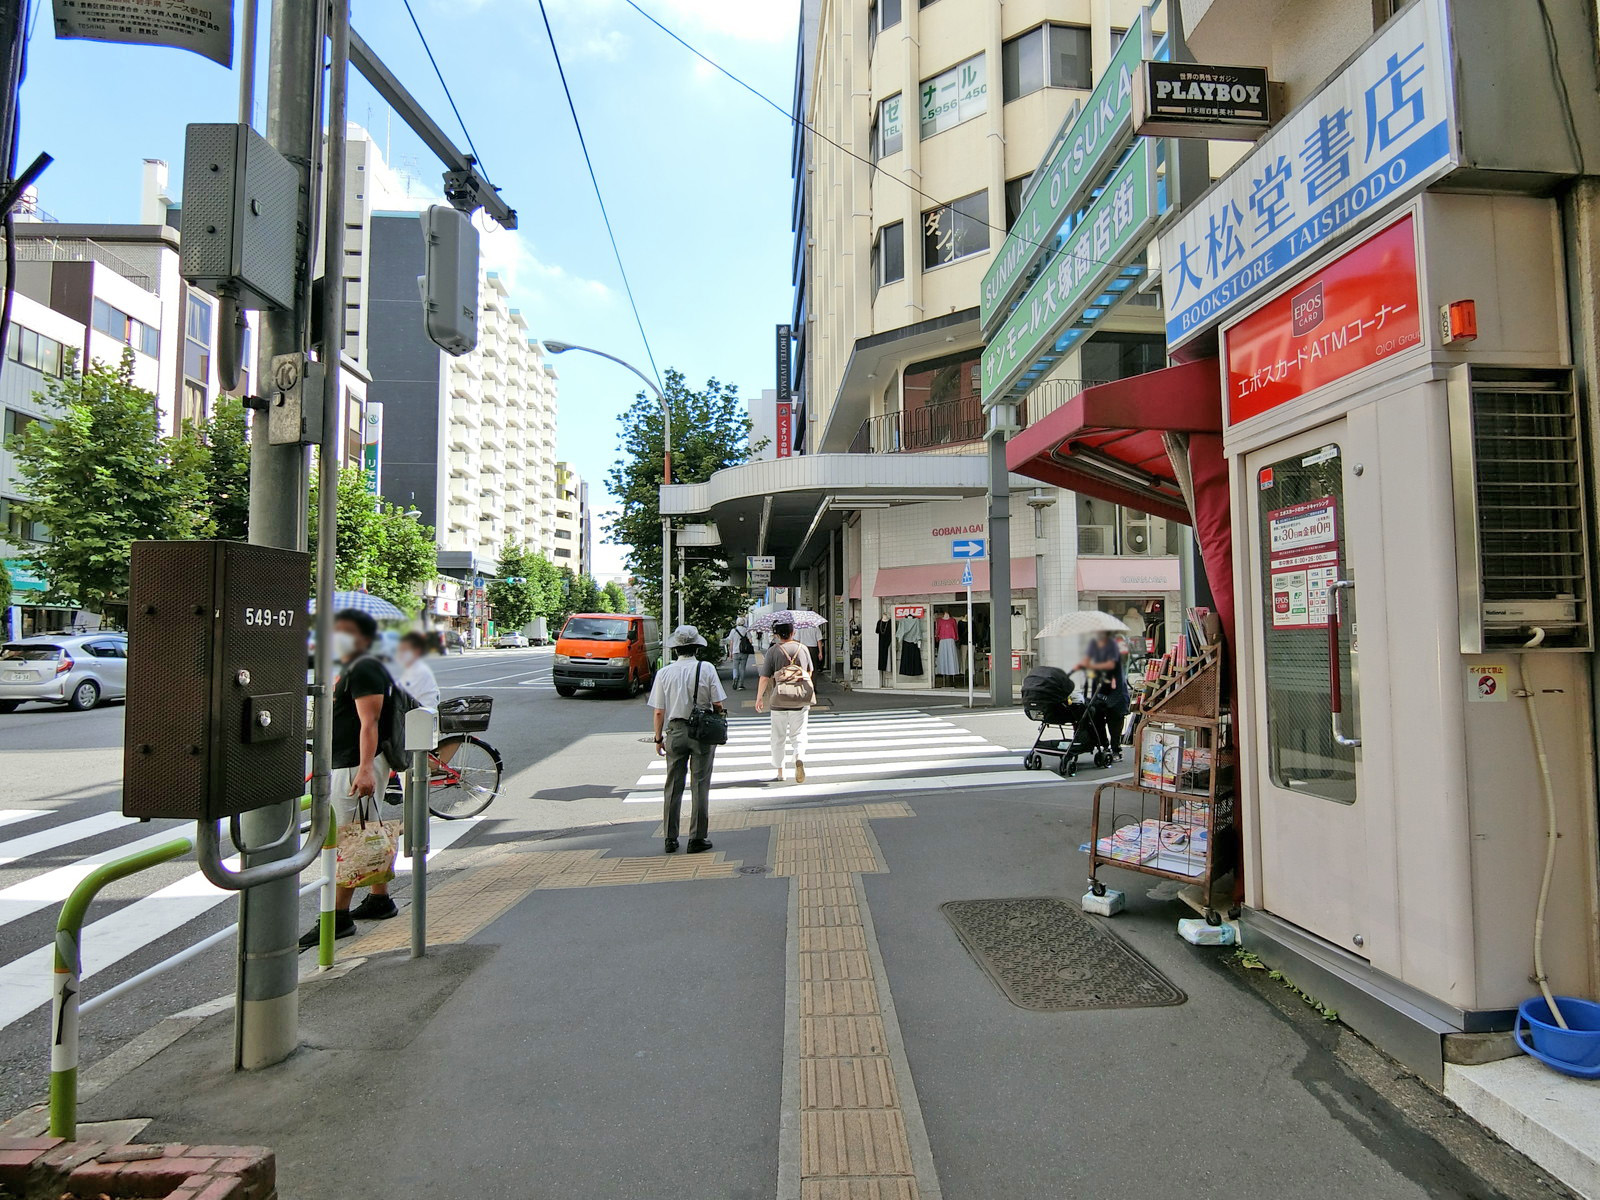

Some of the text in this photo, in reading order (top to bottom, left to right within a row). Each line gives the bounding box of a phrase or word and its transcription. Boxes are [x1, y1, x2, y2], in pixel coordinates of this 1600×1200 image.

[922, 65, 977, 109] ナール
[1179, 72, 1239, 83] 世界の男性マガジン
[1156, 80, 1261, 104] PLAYBOY
[884, 125, 900, 137] TEL
[1168, 42, 1426, 312] 大松堂書店
[1181, 157, 1407, 331] BOOKSTORE TAISHODO
[985, 208, 1042, 310] SUNMALL
[985, 174, 1134, 386] サンモール大塚商店街
[1293, 293, 1323, 321] EPOS
[1298, 309, 1319, 327] CARD
[1441, 311, 1450, 338] SECOM
[1237, 301, 1408, 400] エポスカードATMコーナー
[780, 363, 788, 398] LIVEMAX
[932, 524, 984, 537] GOBAN GAI
[1273, 521, 1331, 542] 最大30日間金利0円
[245, 607, 294, 627] 549-67
[895, 607, 924, 618] SALE
[1469, 666, 1504, 674] ポイ捨て禁止
